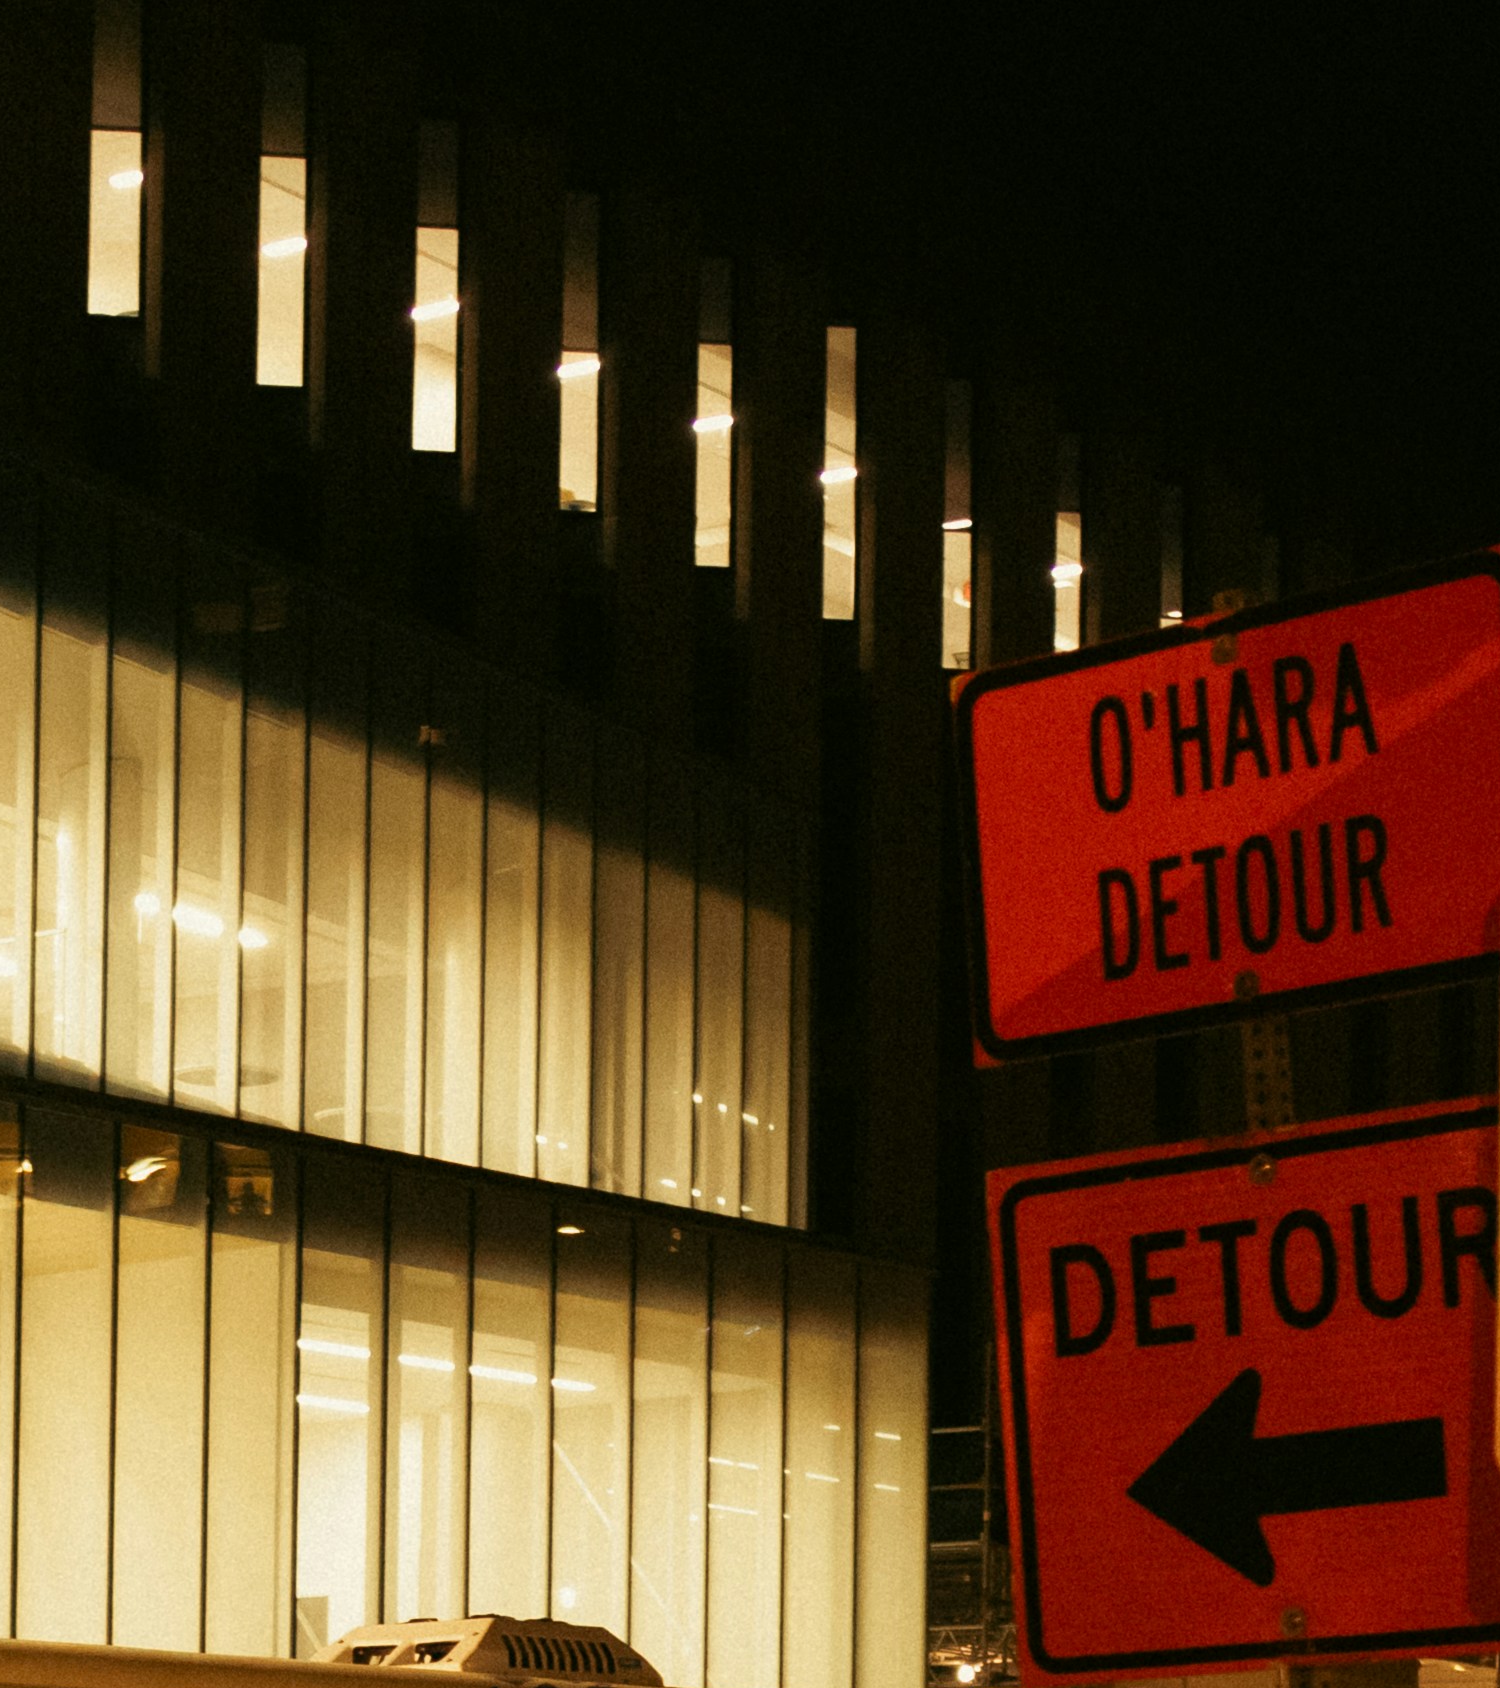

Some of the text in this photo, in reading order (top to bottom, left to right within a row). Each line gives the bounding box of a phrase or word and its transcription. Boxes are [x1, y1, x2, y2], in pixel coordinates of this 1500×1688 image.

[1090, 642, 1380, 814] O'HARA
[1097, 814, 1393, 982] DETOUR
[1048, 1186, 1499, 1358] DETOUR
